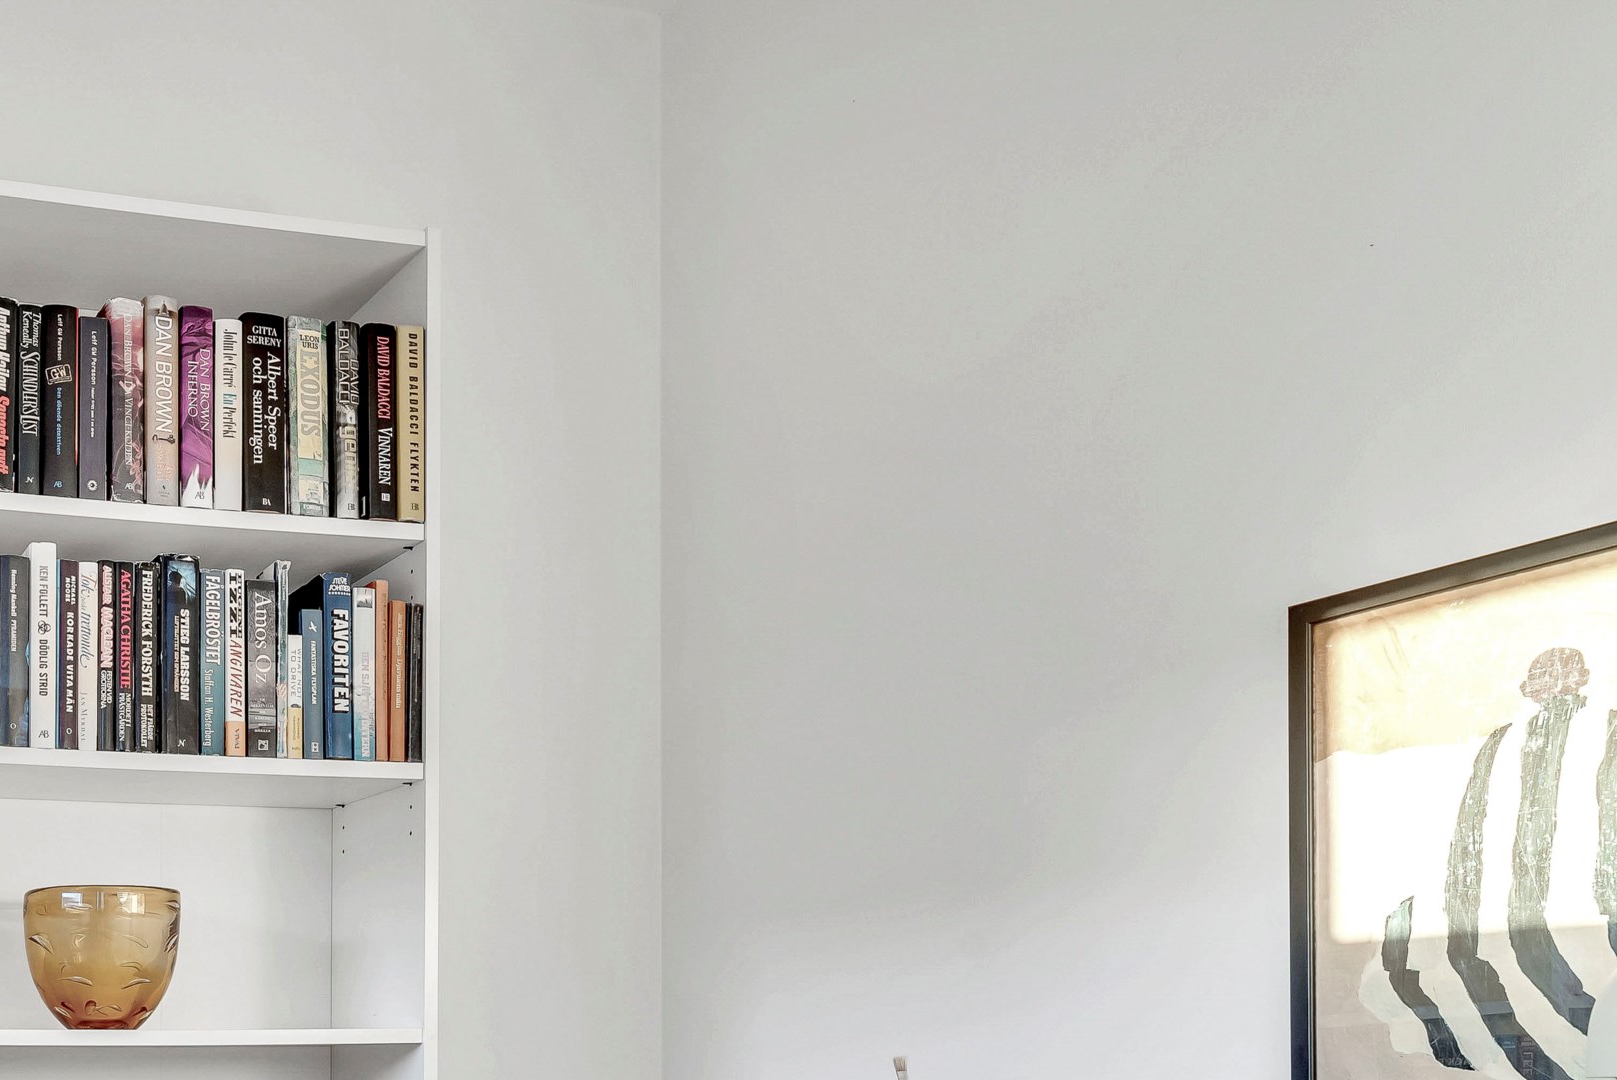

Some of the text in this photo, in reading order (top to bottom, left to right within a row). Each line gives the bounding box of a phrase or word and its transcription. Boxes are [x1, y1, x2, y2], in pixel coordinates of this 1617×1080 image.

[155, 316, 174, 433] DAN BROWN
[187, 360, 198, 418] INFERNO
[198, 349, 210, 432] DAN BROWN
[267, 352, 281, 451] Albert Speer
[300, 351, 321, 436] EXODUS
[376, 336, 393, 486] DAVID BALDACCI VINNAREN
[39, 565, 49, 696] KEN FOLLETT DÖDLIG STRID
[120, 569, 132, 689] AGATHA CHRISTIE
[230, 640, 242, 717] ANGIVAREN
[331, 609, 351, 714] FAVORITEN
